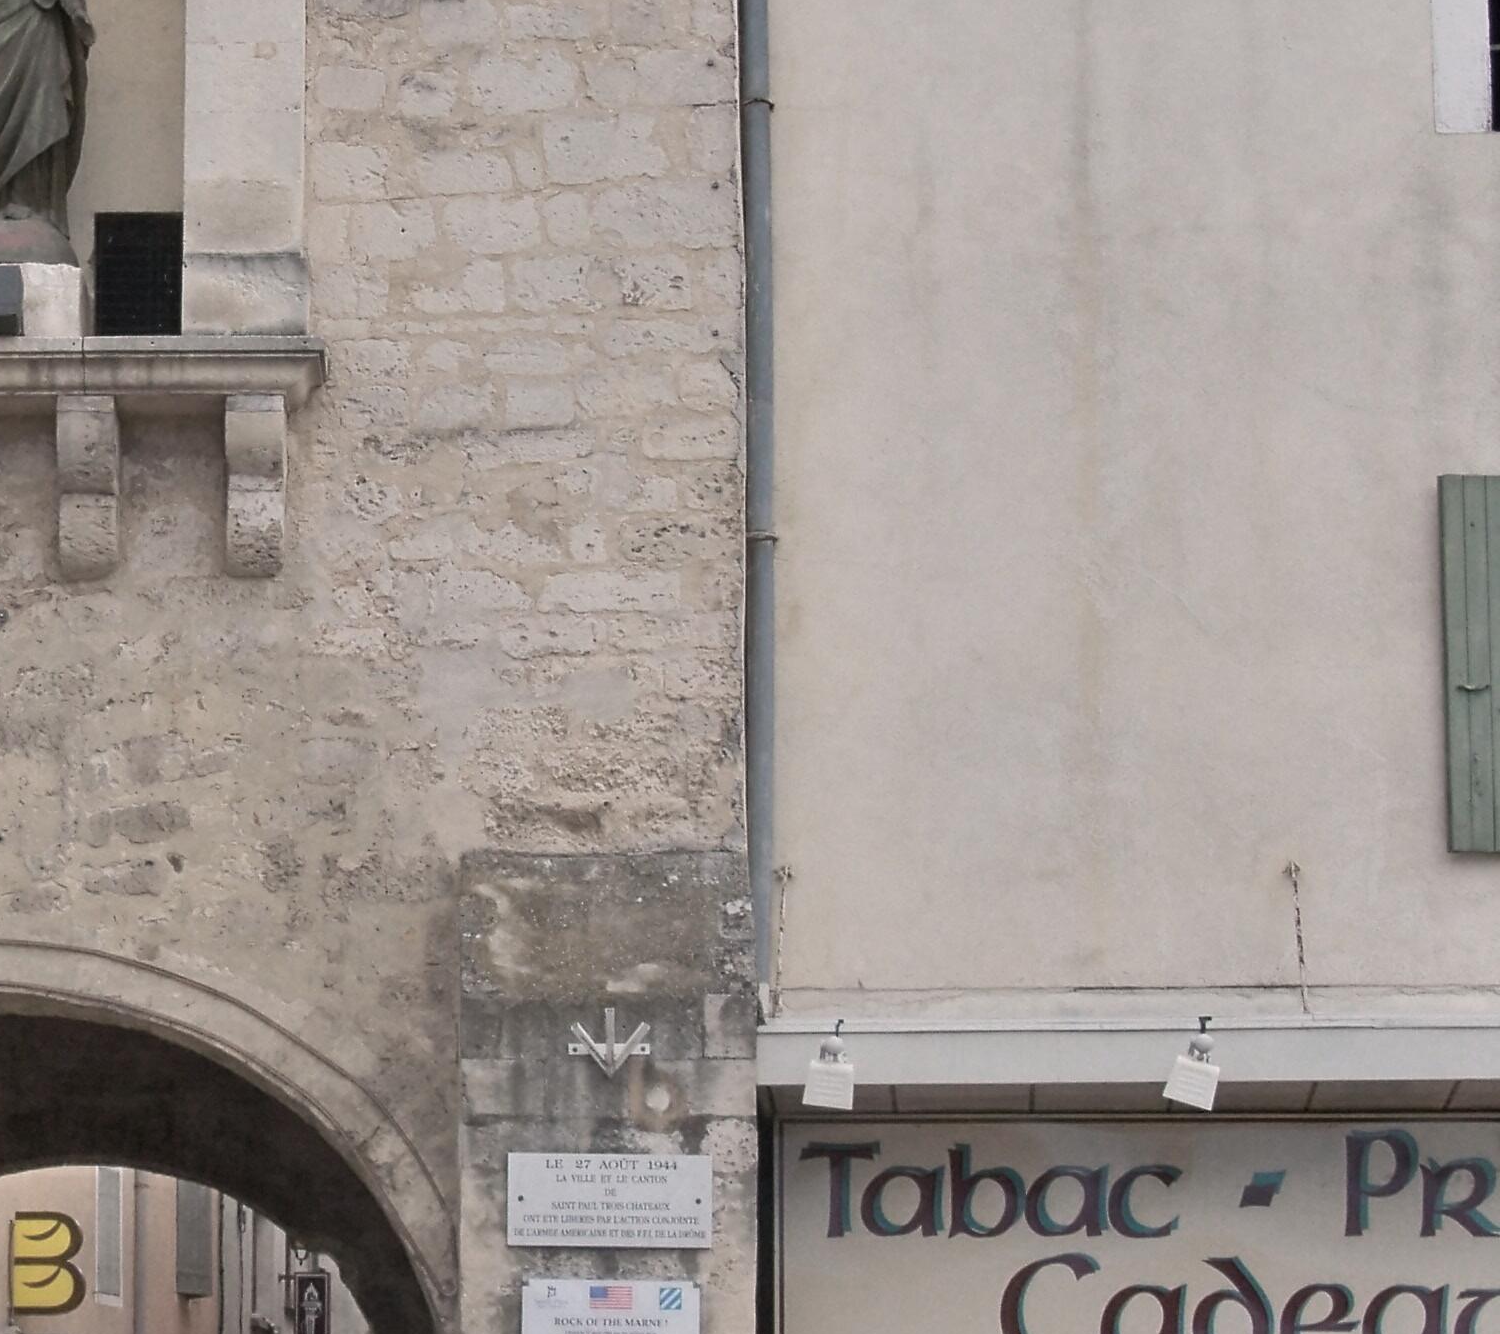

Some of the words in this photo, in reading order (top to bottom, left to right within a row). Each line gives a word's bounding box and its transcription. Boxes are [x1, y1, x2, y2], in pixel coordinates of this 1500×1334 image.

[545, 1159, 563, 1169] LE
[575, 1159, 591, 1169] 27
[599, 1157, 639, 1170] AOÛT
[648, 1160, 677, 1171] 1944
[556, 1174, 567, 1183] LA
[571, 1174, 596, 1183] VILLE
[601, 1175, 612, 1184] ET
[616, 1175, 627, 1184] LE
[631, 1175, 668, 1184] CANTON
[604, 1188, 617, 1197] DE
[800, 1142, 1185, 1238] Tabac
[551, 1201, 576, 1210] SAINT
[578, 1201, 598, 1210] PAUL
[554, 1317, 583, 1326] ROCK
[586, 1318, 597, 1326] OF
[603, 1318, 620, 1327] THE
[625, 1318, 661, 1328] MARNE
